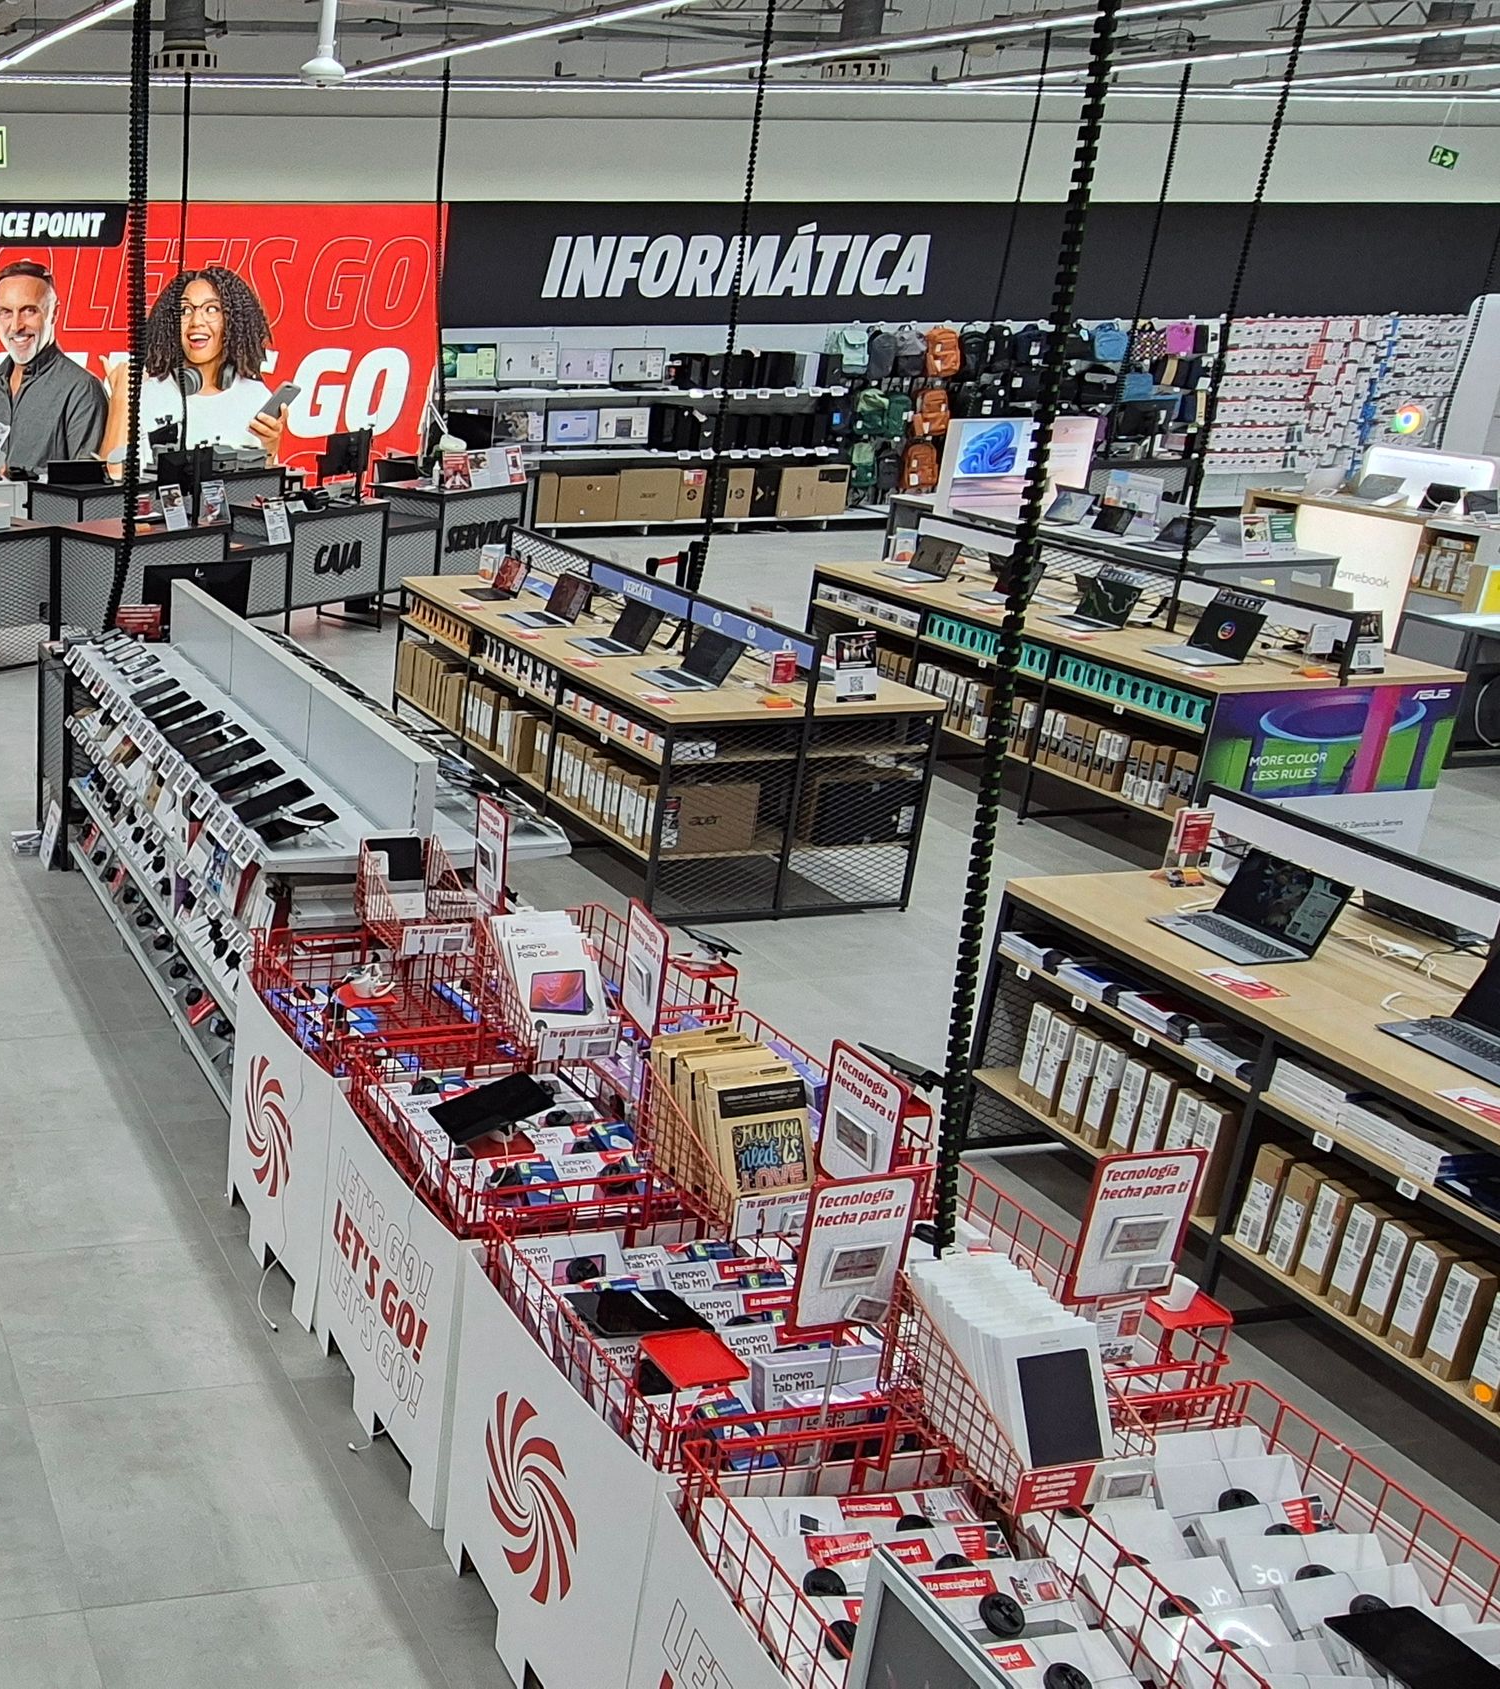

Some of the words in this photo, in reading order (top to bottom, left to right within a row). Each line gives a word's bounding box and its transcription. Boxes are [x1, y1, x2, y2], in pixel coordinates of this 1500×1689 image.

[31, 211, 106, 238] POINT
[541, 222, 931, 297] INFORMÁTICA
[304, 236, 431, 331] GO
[285, 347, 411, 438] GO
[445, 517, 519, 553] SERVIC
[314, 541, 363, 575] CAJA
[1337, 569, 1390, 589] omebook
[1412, 688, 1451, 700] ASUS
[1249, 754, 1284, 768] MORE
[1286, 752, 1328, 766] COLOR
[1252, 770, 1278, 782] LESS
[1281, 767, 1318, 780] RULES
[689, 815, 722, 826] acer
[515, 943, 547, 951] Lenovo
[517, 951, 538, 959] Folio
[838, 1055, 888, 1099] Tecnología
[401, 1099, 433, 1108] Lenovo
[834, 1073, 863, 1099] hecha
[862, 1094, 887, 1118] para
[887, 1111, 896, 1124] ti
[530, 1131, 558, 1140] enovo
[771, 1119, 800, 1147] you
[557, 1158, 591, 1167] Lenovo
[739, 1142, 778, 1170] need
[560, 1165, 577, 1173] Tab
[580, 1164, 595, 1173] M11
[1105, 1163, 1180, 1185] Tecnología
[739, 1162, 807, 1192] LOVE
[1100, 1185, 1141, 1200] hecha
[1142, 1183, 1177, 1199] para
[1178, 1179, 1191, 1194] ti
[757, 1198, 776, 1207] será
[778, 1196, 798, 1205] muy
[819, 1188, 894, 1209] Tecnología
[814, 1211, 857, 1227] hecha
[858, 1210, 891, 1225] para
[893, 1204, 906, 1217] ti
[336, 1146, 386, 1248] LET'S
[383, 1222, 434, 1311] GO!
[534, 1254, 552, 1265] M11
[623, 1252, 658, 1262] Lenovo
[626, 1261, 645, 1270] Tab
[648, 1258, 665, 1267] M11
[333, 1199, 381, 1299] LET'S
[380, 1277, 429, 1365] GO!
[669, 1268, 707, 1281] Lenovo
[671, 1281, 690, 1291] Tab
[692, 1278, 711, 1289] M11
[693, 1300, 732, 1310] Lenovo
[716, 1310, 735, 1319] M11
[330, 1248, 376, 1352] LET'S
[375, 1327, 425, 1419] GO!
[729, 1334, 769, 1346] Lenovo
[732, 1346, 751, 1356] Tab
[753, 1344, 772, 1354] M11
[772, 1370, 814, 1382] Lenovo
[772, 1382, 792, 1393] Tab
[795, 1380, 815, 1391] M11
